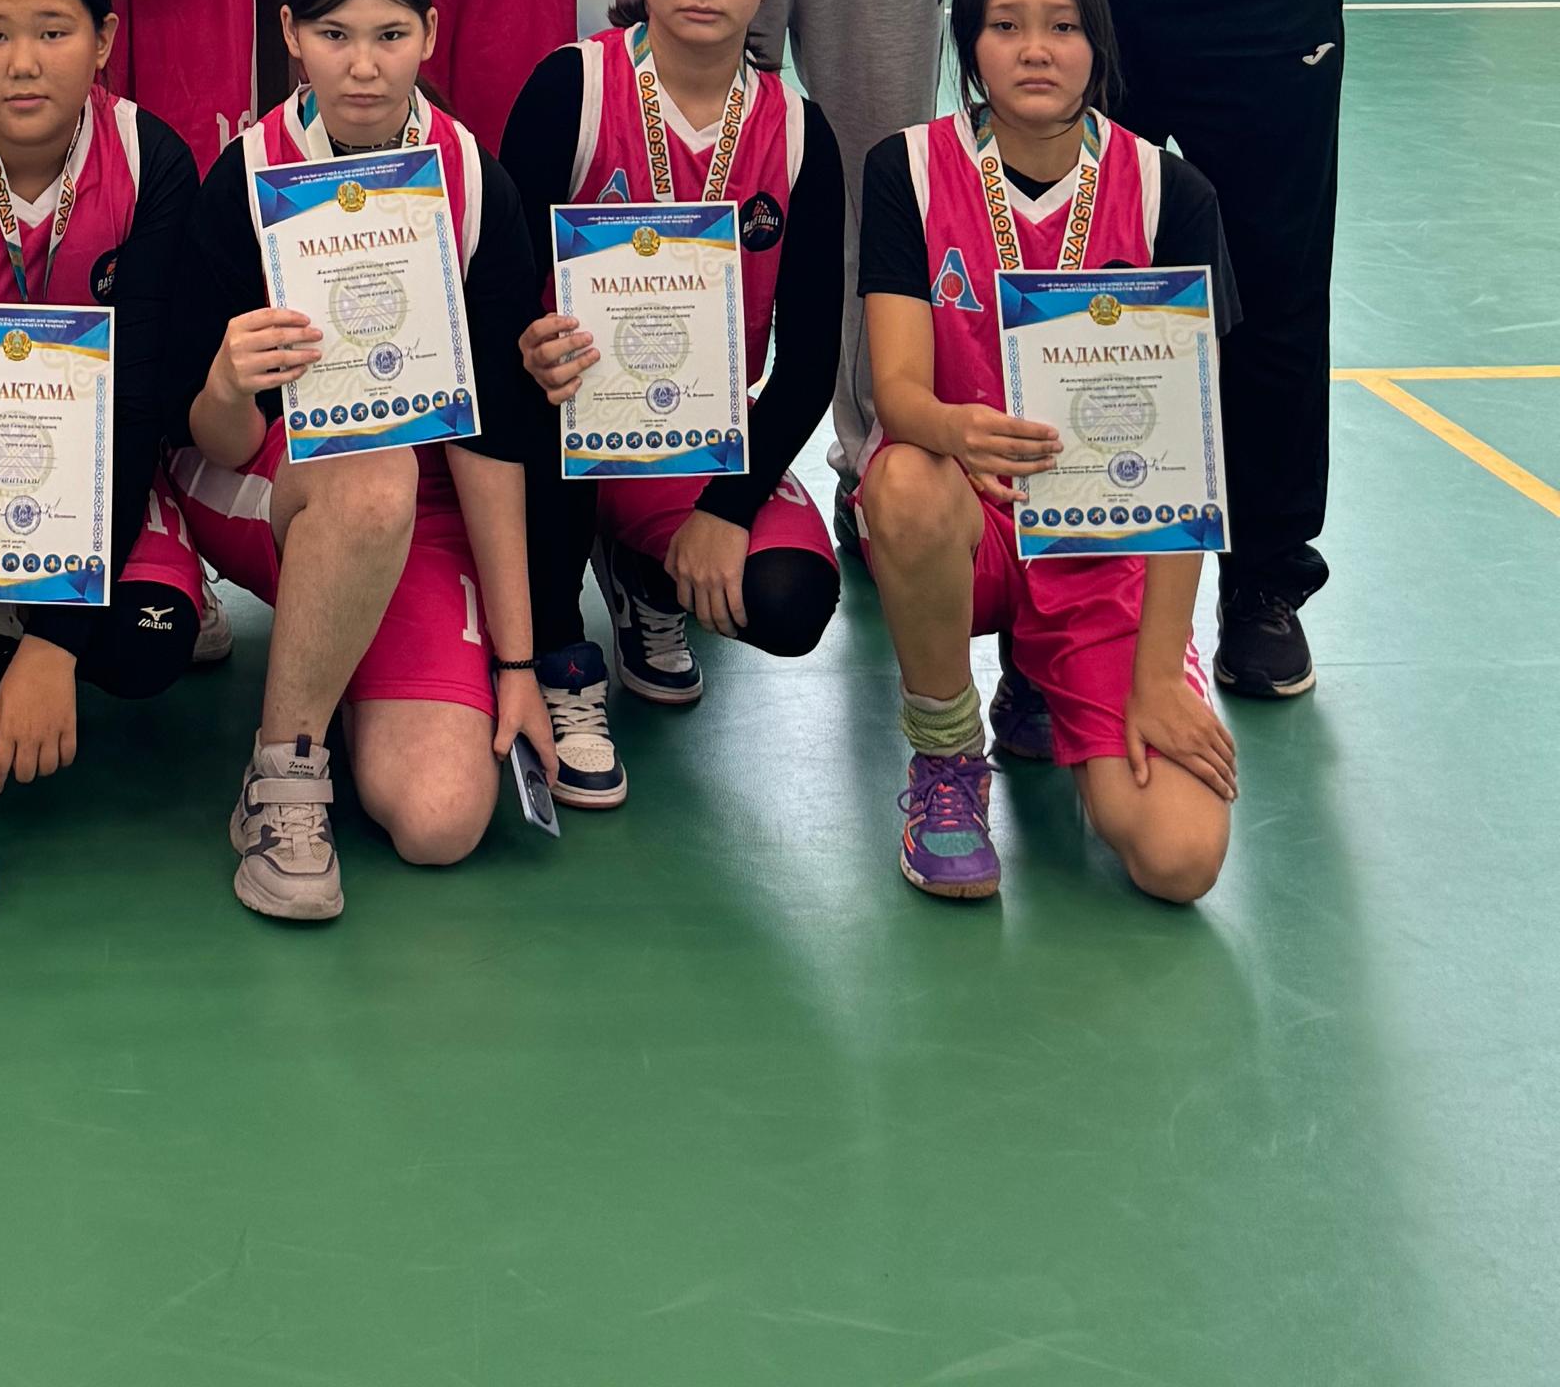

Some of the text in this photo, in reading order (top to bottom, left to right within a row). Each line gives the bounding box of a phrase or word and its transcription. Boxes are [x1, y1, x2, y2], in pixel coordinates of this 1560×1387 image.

[639, 71, 671, 194] QAZAQSTAN
[981, 156, 1021, 271] QAZAQSTA
[298, 226, 421, 258] МАДАҚТАМА
[591, 274, 707, 296] МАДАҚТАМА
[1042, 344, 1175, 367] МАДАҚТАМА
[138, 618, 173, 630] MIZUNO
